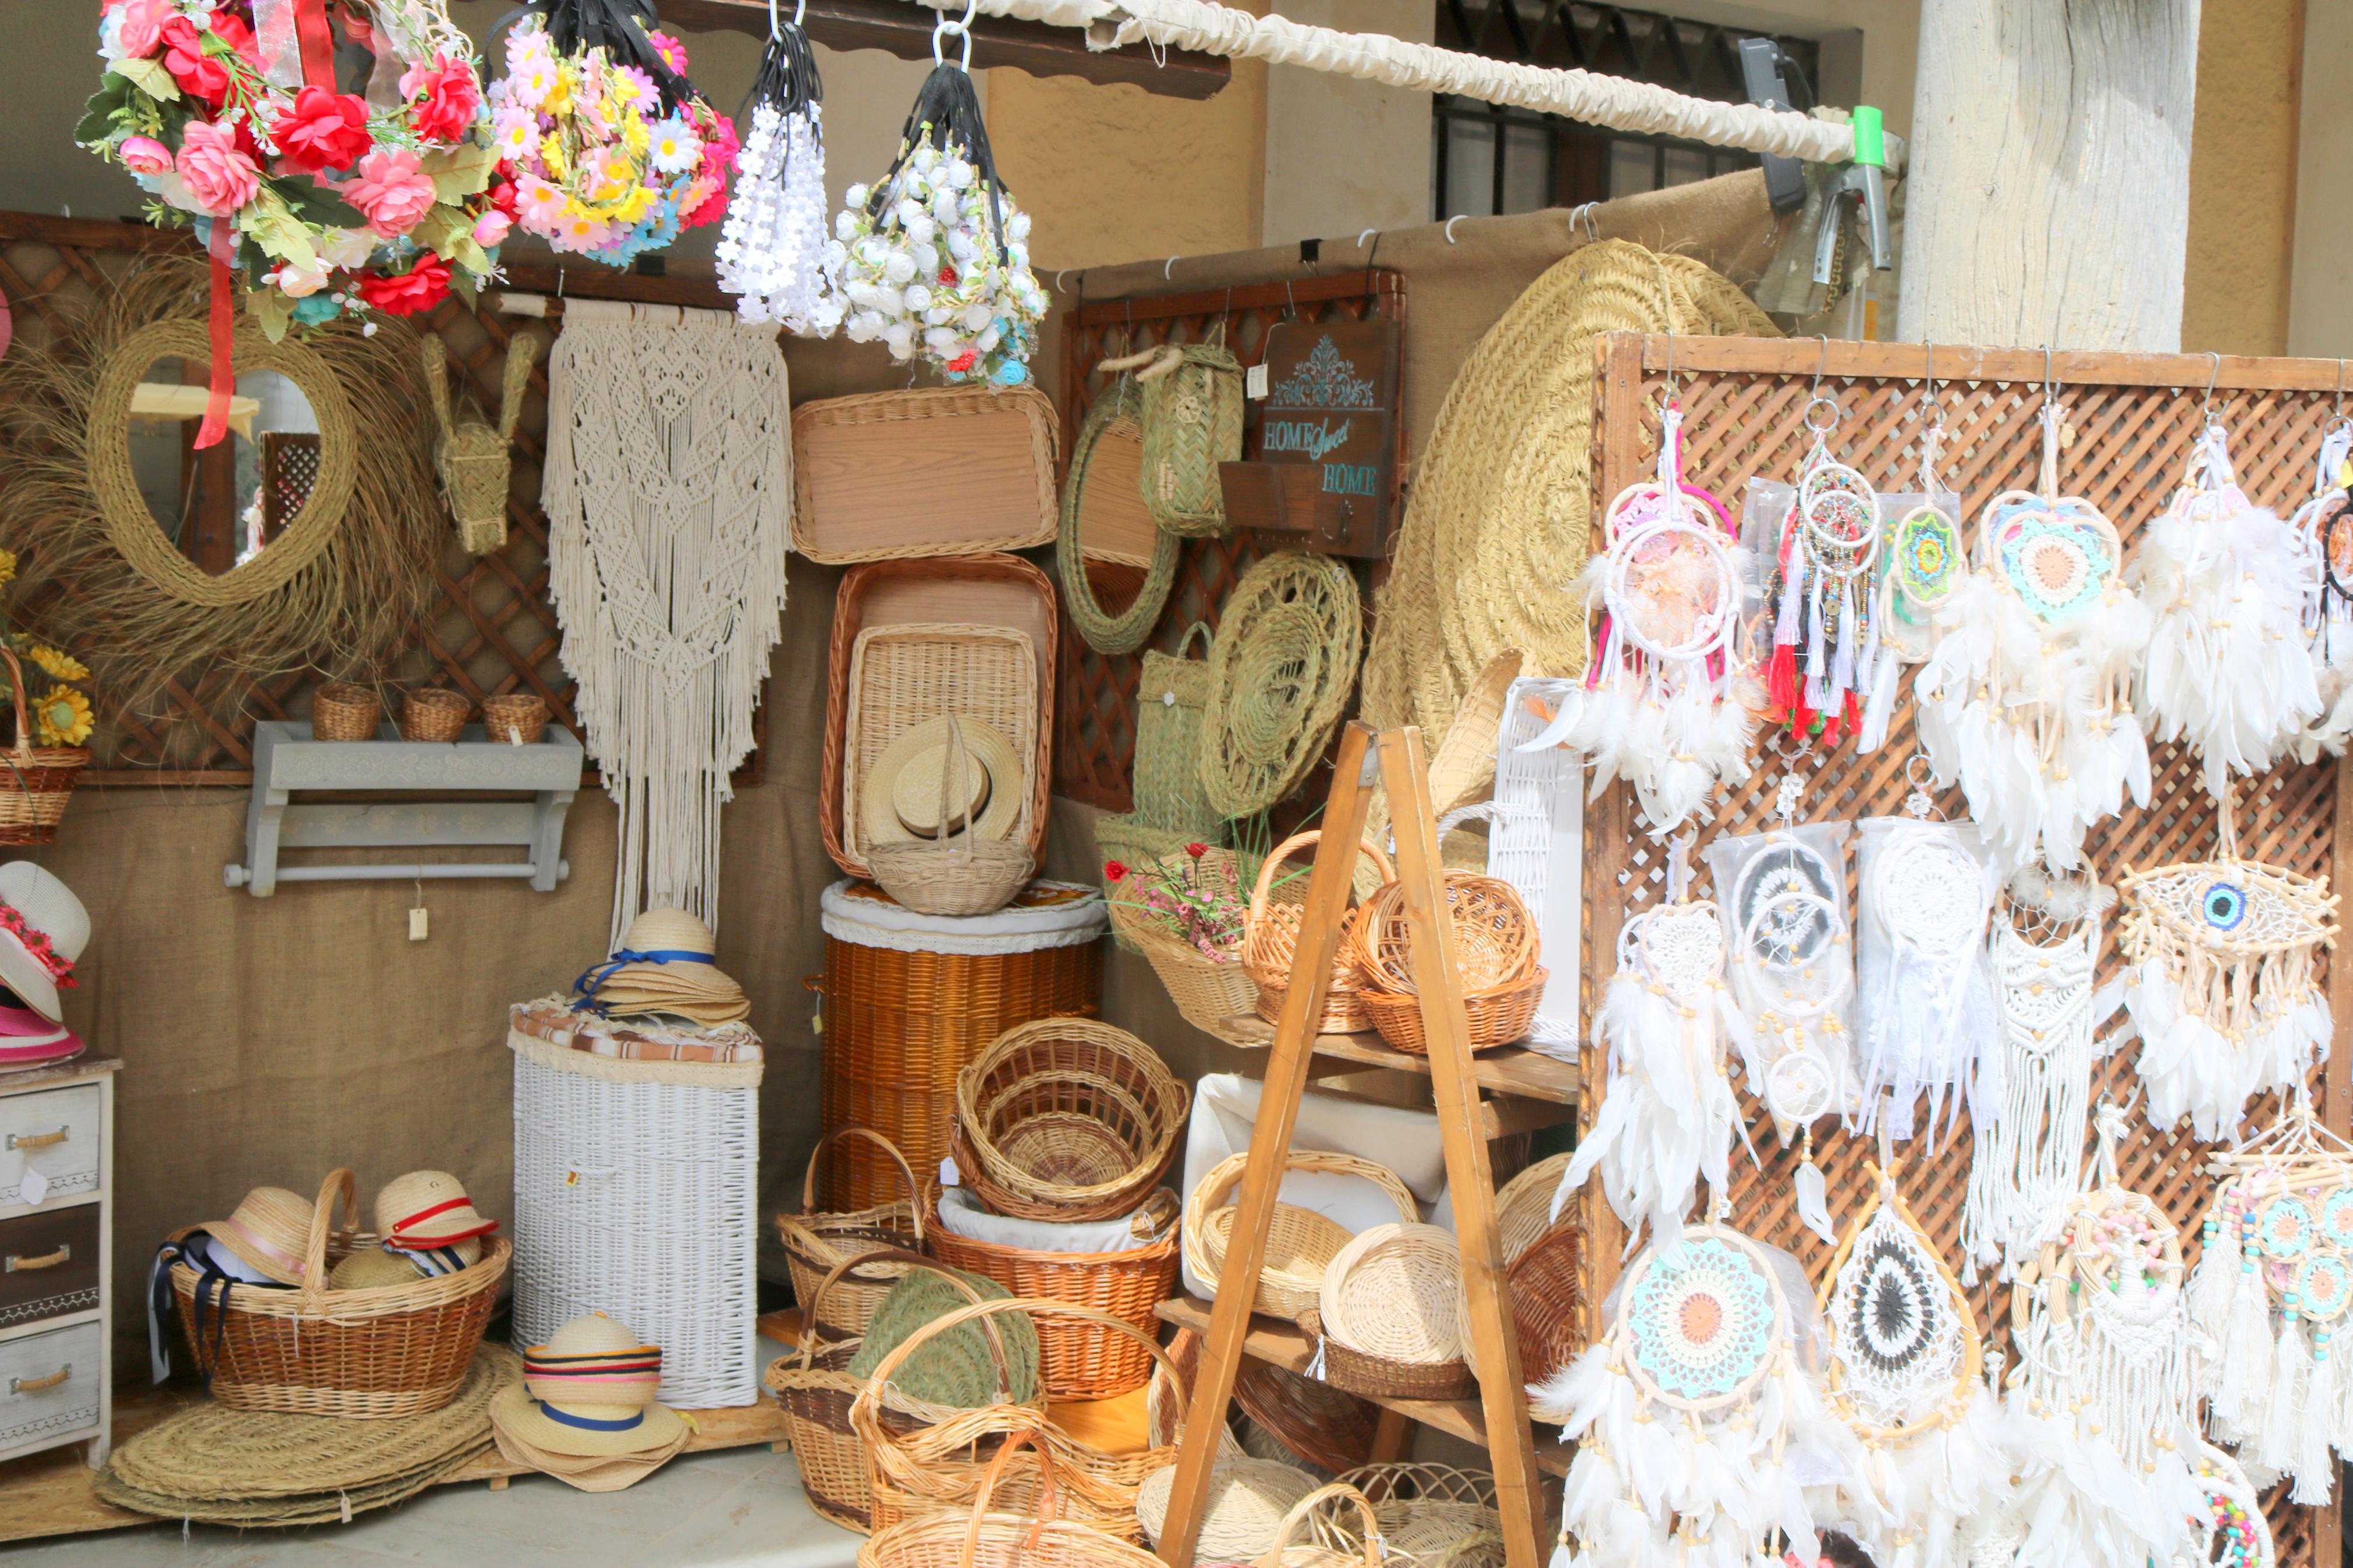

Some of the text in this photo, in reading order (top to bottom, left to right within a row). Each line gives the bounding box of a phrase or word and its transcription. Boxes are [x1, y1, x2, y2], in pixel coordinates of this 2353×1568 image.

[1263, 417, 1350, 460] HOME Sweet
[1322, 463, 1378, 496] HOME
